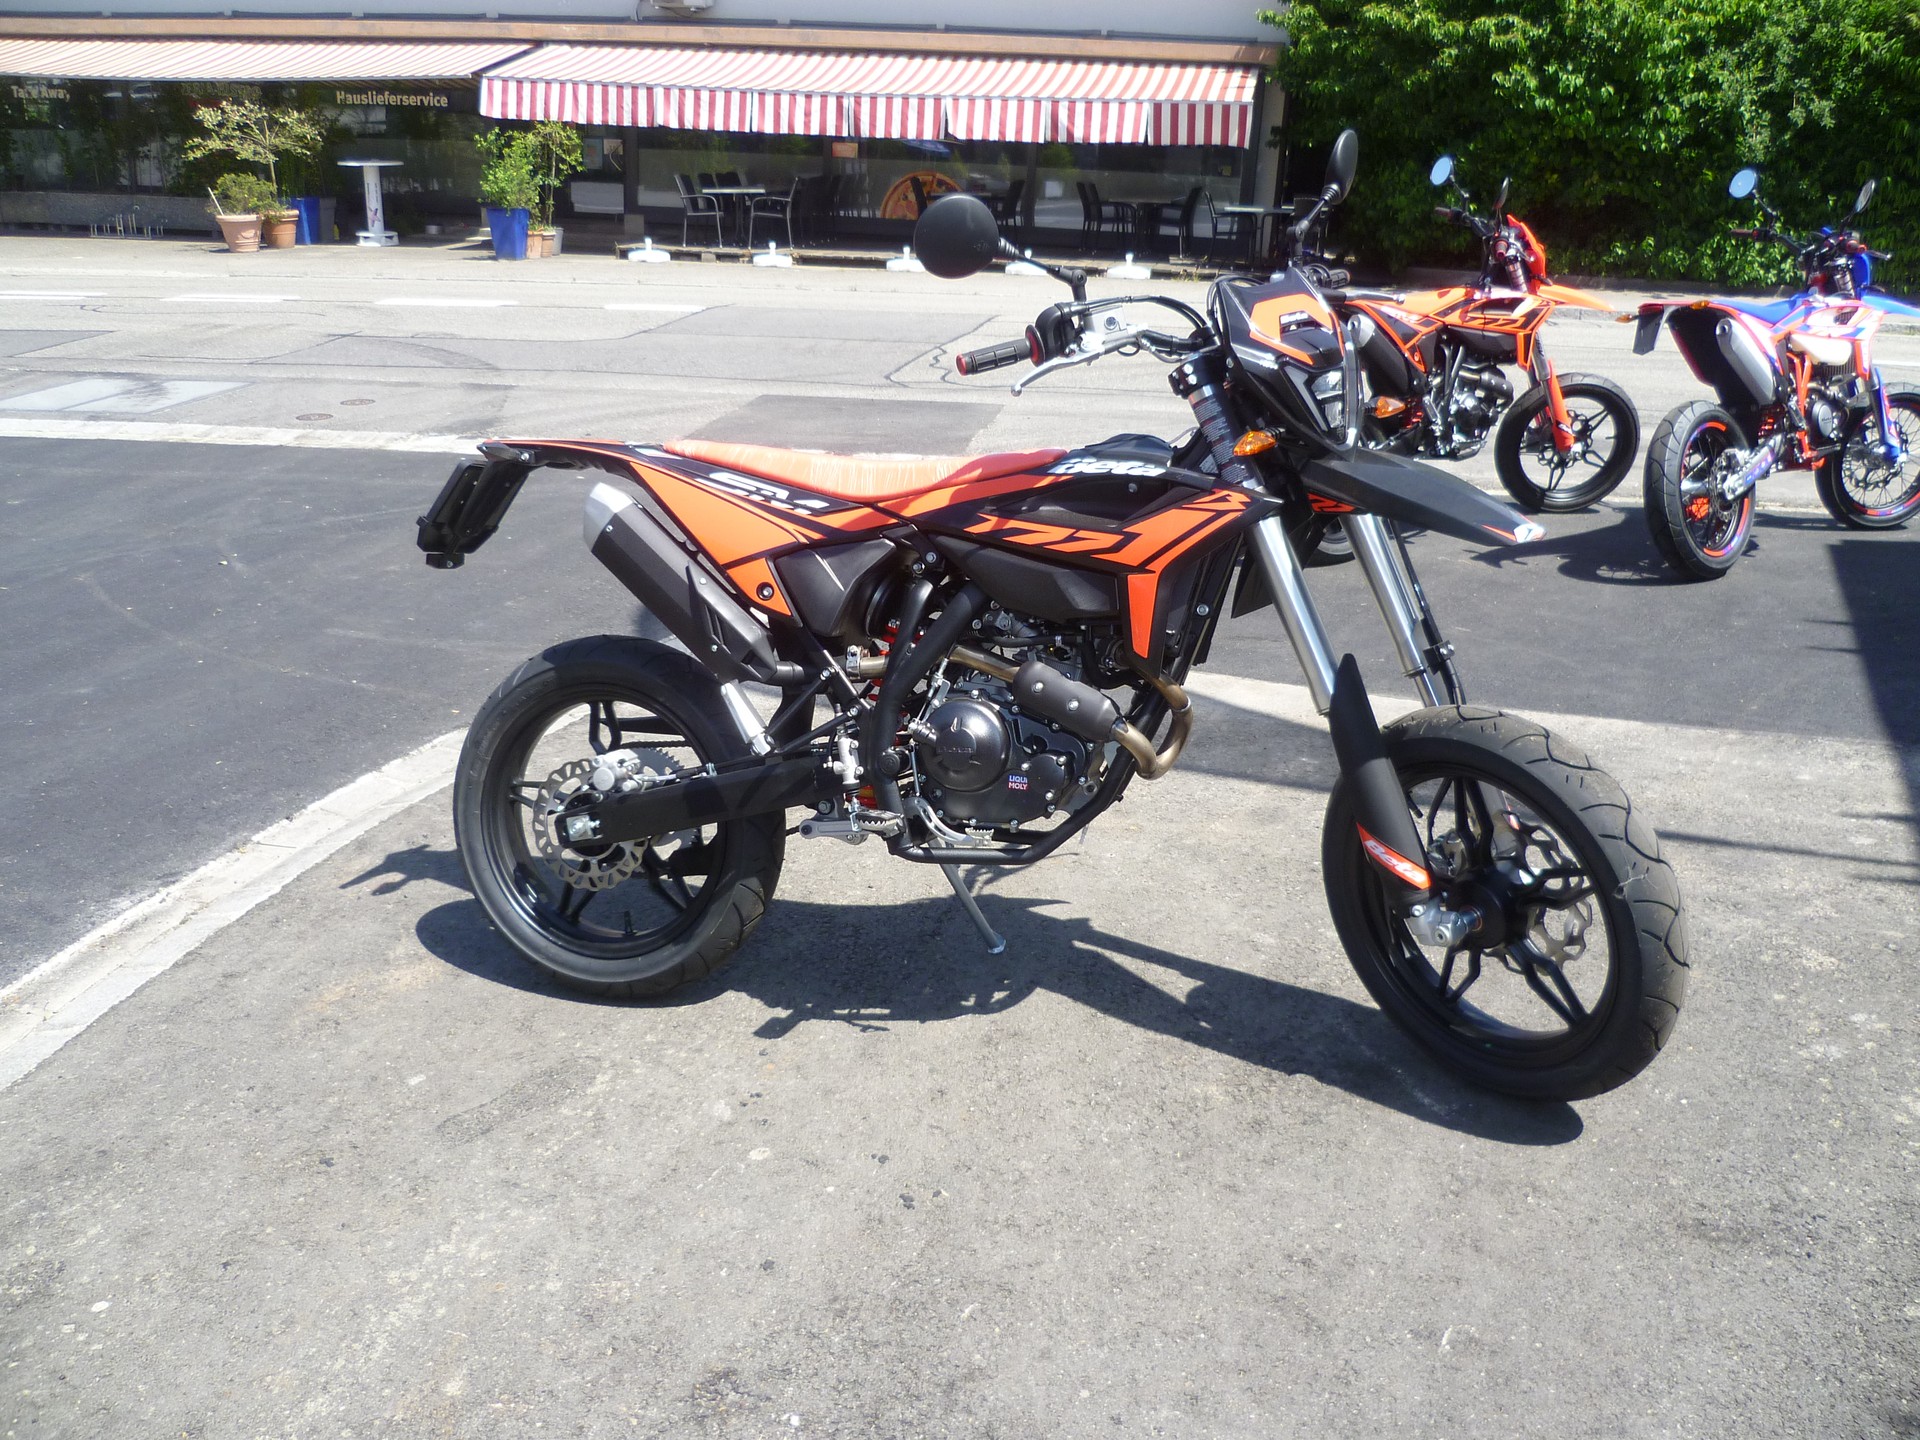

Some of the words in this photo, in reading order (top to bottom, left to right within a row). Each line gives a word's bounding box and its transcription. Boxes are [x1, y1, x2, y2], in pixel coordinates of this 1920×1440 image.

[335, 90, 449, 107] Hauslieferservice
[1009, 774, 1028, 783] LIQUI
[1008, 782, 1028, 790] MOLY
[1364, 839, 1426, 883] Beta
